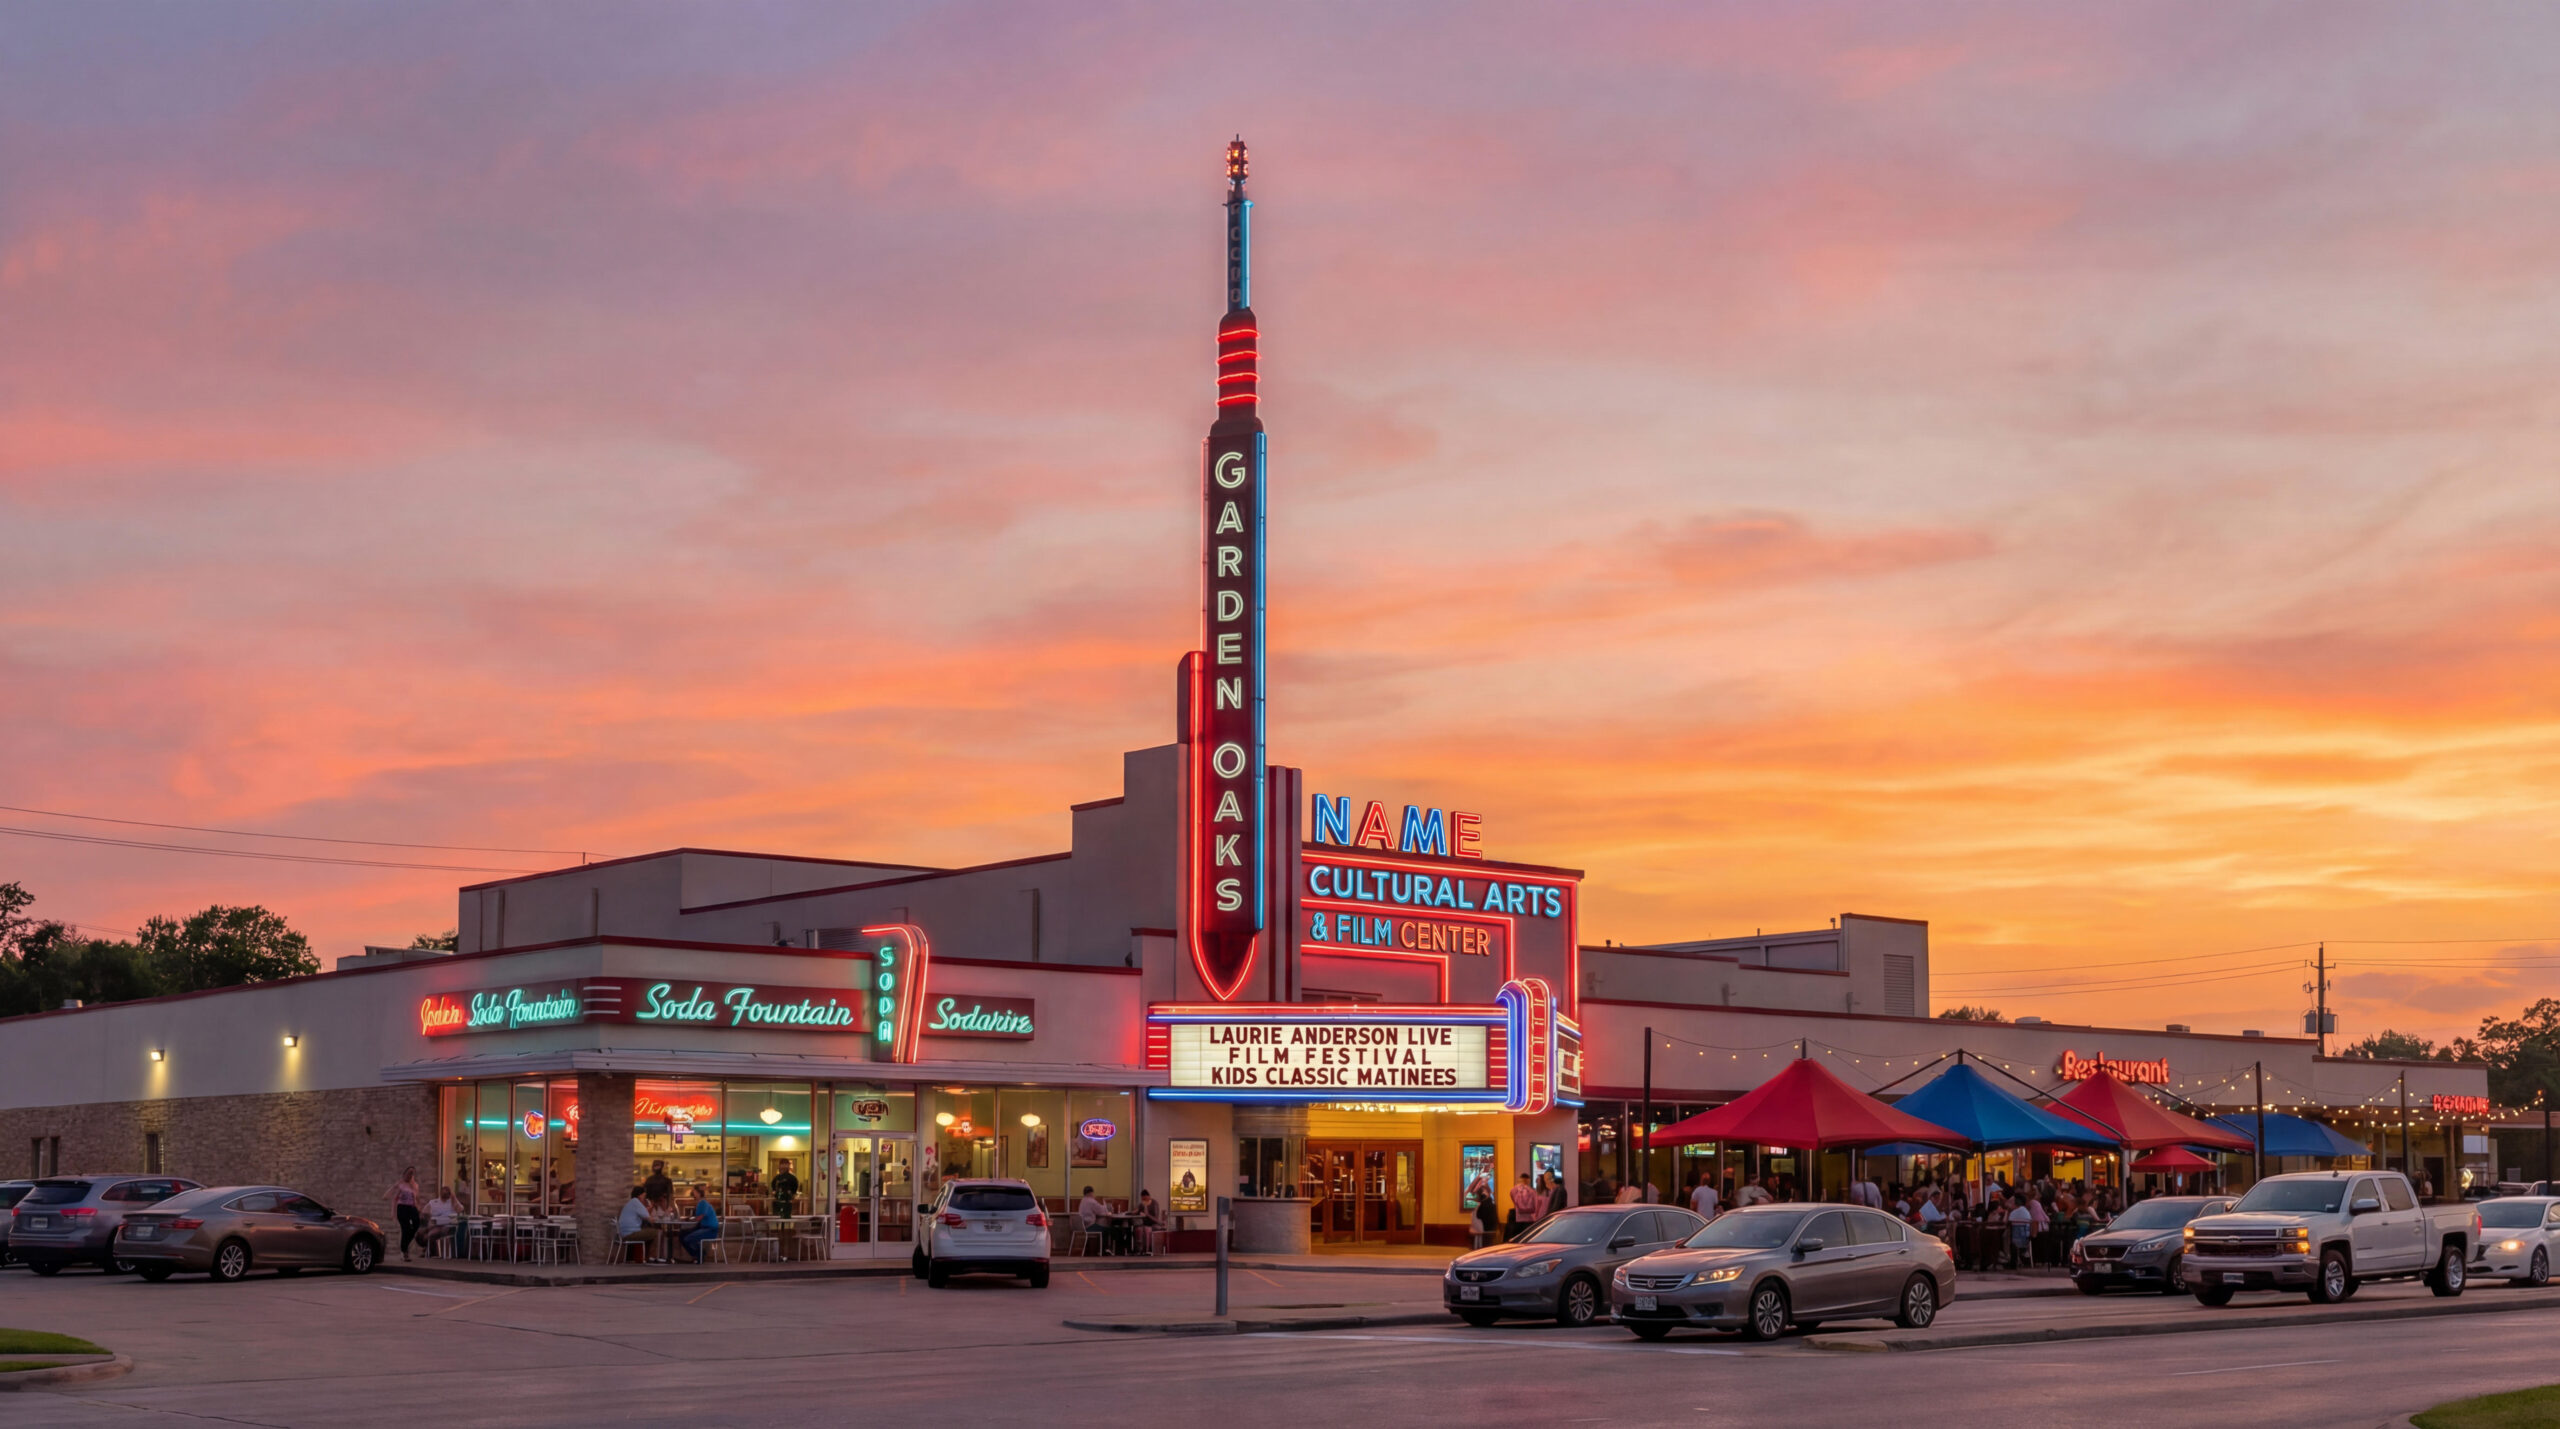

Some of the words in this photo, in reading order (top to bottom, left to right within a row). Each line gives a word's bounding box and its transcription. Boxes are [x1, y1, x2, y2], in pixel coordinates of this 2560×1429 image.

[1215, 451, 1246, 710] GARDEN
[1212, 742, 1246, 911] OAKS
[1312, 793, 1482, 860] NAME
[1310, 865, 1473, 910] CULTURAL
[1483, 882, 1562, 918] ARTS
[1310, 912, 1328, 941] &
[1336, 914, 1392, 946] FILM
[1400, 921, 1490, 956] CENTER
[636, 983, 717, 1020] Soda
[724, 987, 853, 1026] Fountain
[878, 946, 895, 1042] SODA
[1210, 1026, 1282, 1045] LAURIE
[1290, 1027, 1398, 1045] ANDERSON
[1408, 1028, 1452, 1045] LIVE
[1229, 1047, 1289, 1064] FILM
[1305, 1047, 1432, 1065] FESTIVAL
[1211, 1067, 1257, 1085] KIDS
[1266, 1067, 1348, 1085] CLASSIC
[1357, 1068, 1456, 1086] MATINEES
